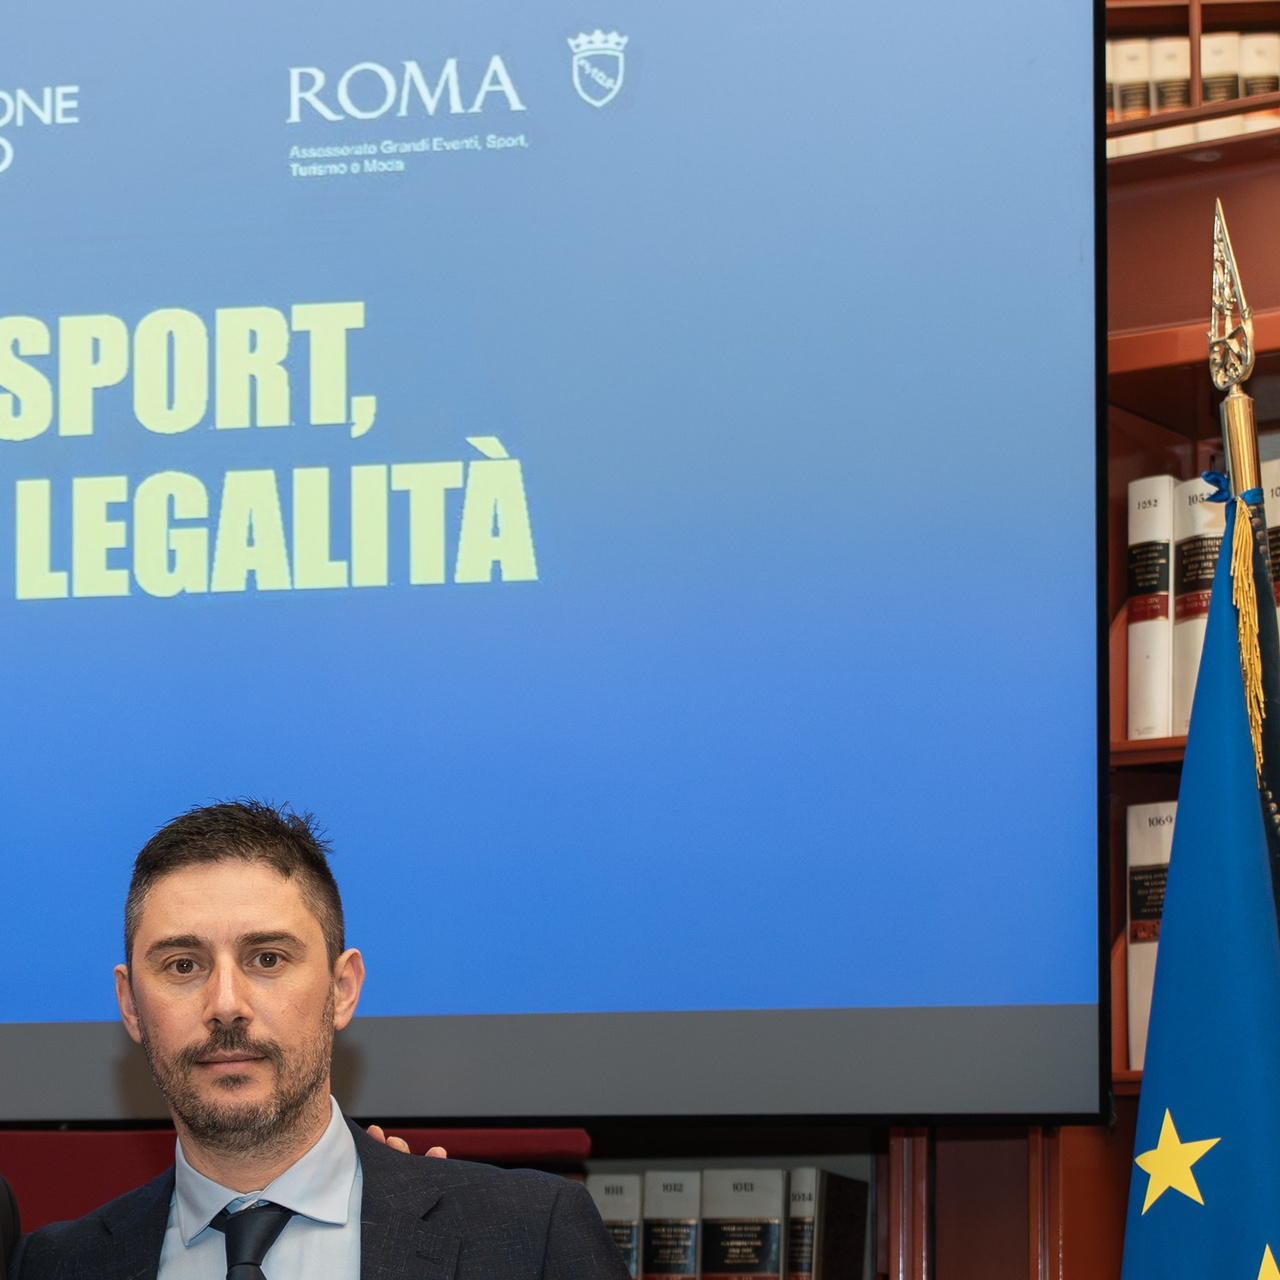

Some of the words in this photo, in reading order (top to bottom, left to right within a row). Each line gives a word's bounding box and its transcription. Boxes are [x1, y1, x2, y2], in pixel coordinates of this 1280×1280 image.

[285, 54, 527, 123] ROMA
[380, 137, 431, 155] Grandi
[289, 161, 348, 177] Turismo
[363, 159, 405, 173] Moda
[1137, 498, 1158, 511] 1052
[16, 436, 539, 600] LEGALITÀ
[1148, 816, 1173, 828] 1069
